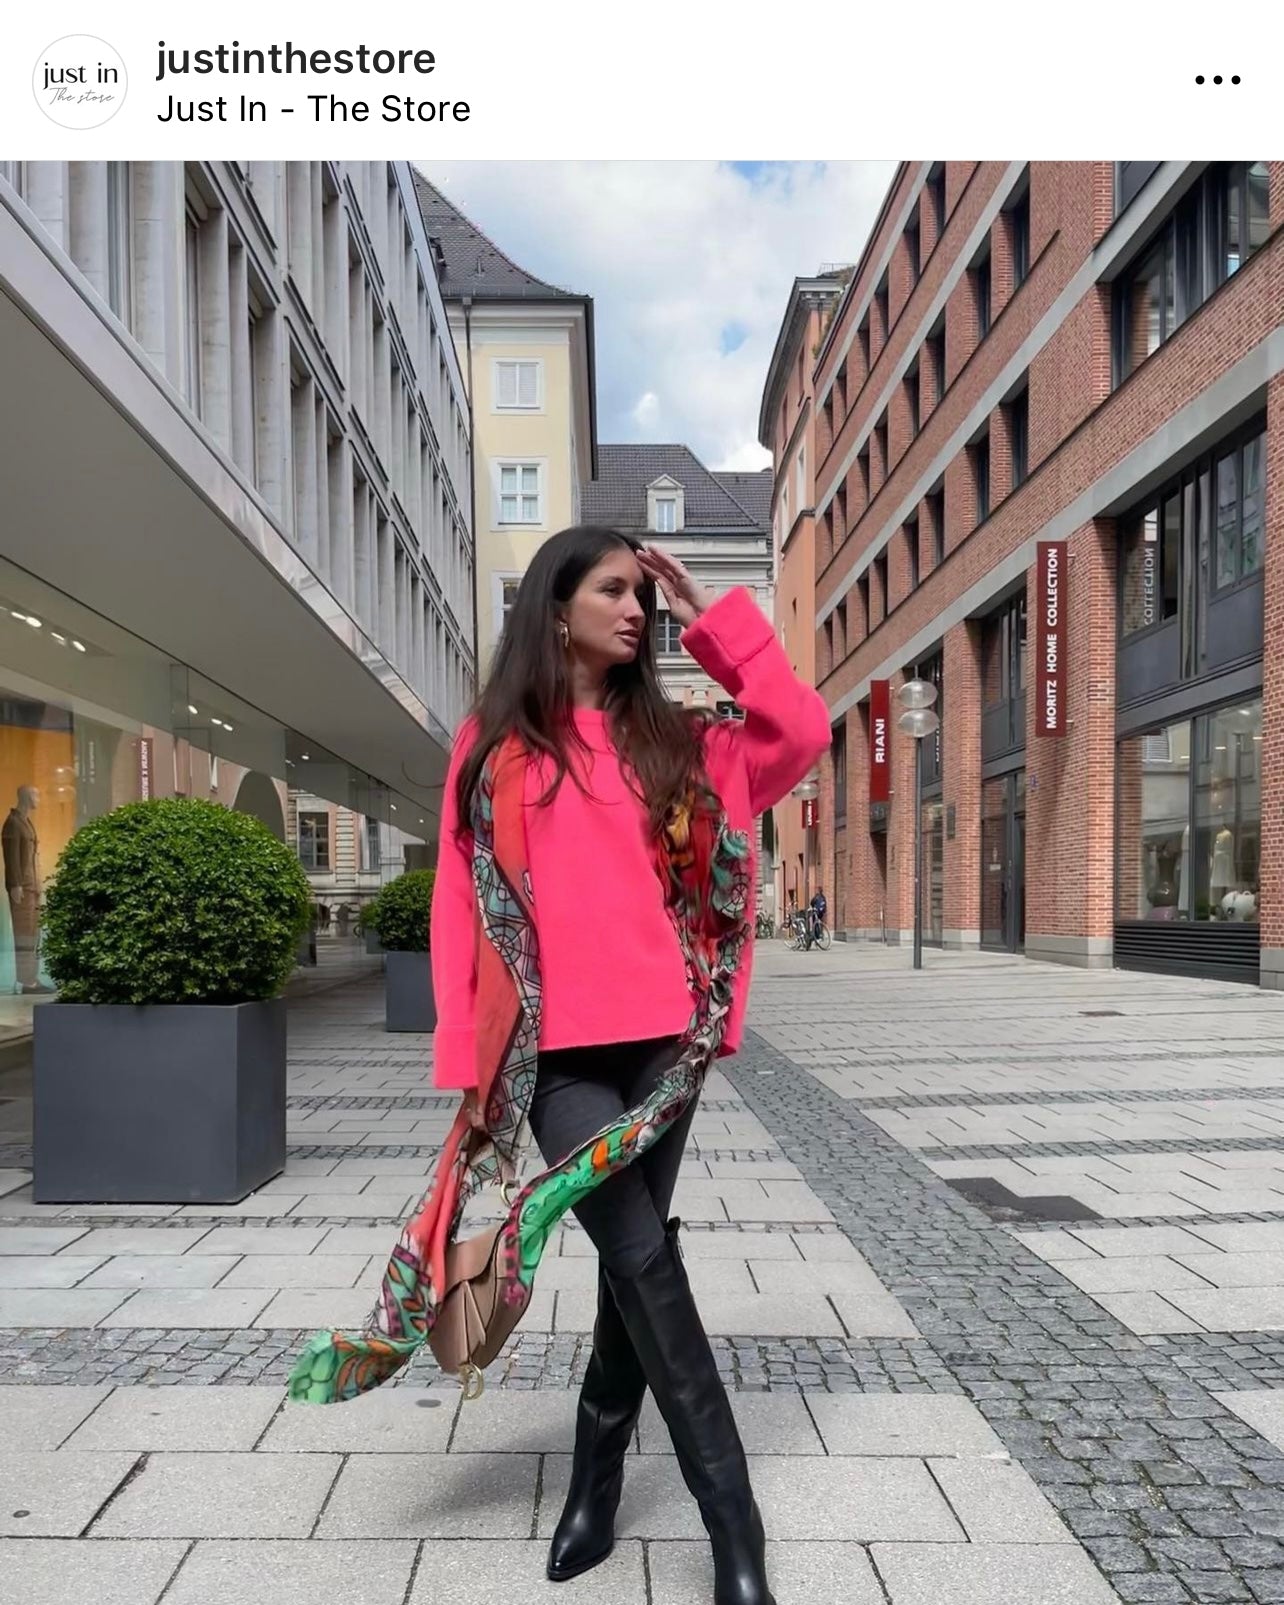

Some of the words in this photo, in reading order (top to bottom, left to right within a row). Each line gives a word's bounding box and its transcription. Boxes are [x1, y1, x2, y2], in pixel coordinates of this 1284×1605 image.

[1047, 548, 1058, 627] COLLECTION
[1046, 634, 1057, 673] HOME
[1046, 680, 1057, 729] MORITZ
[875, 718, 885, 763] RIANI
